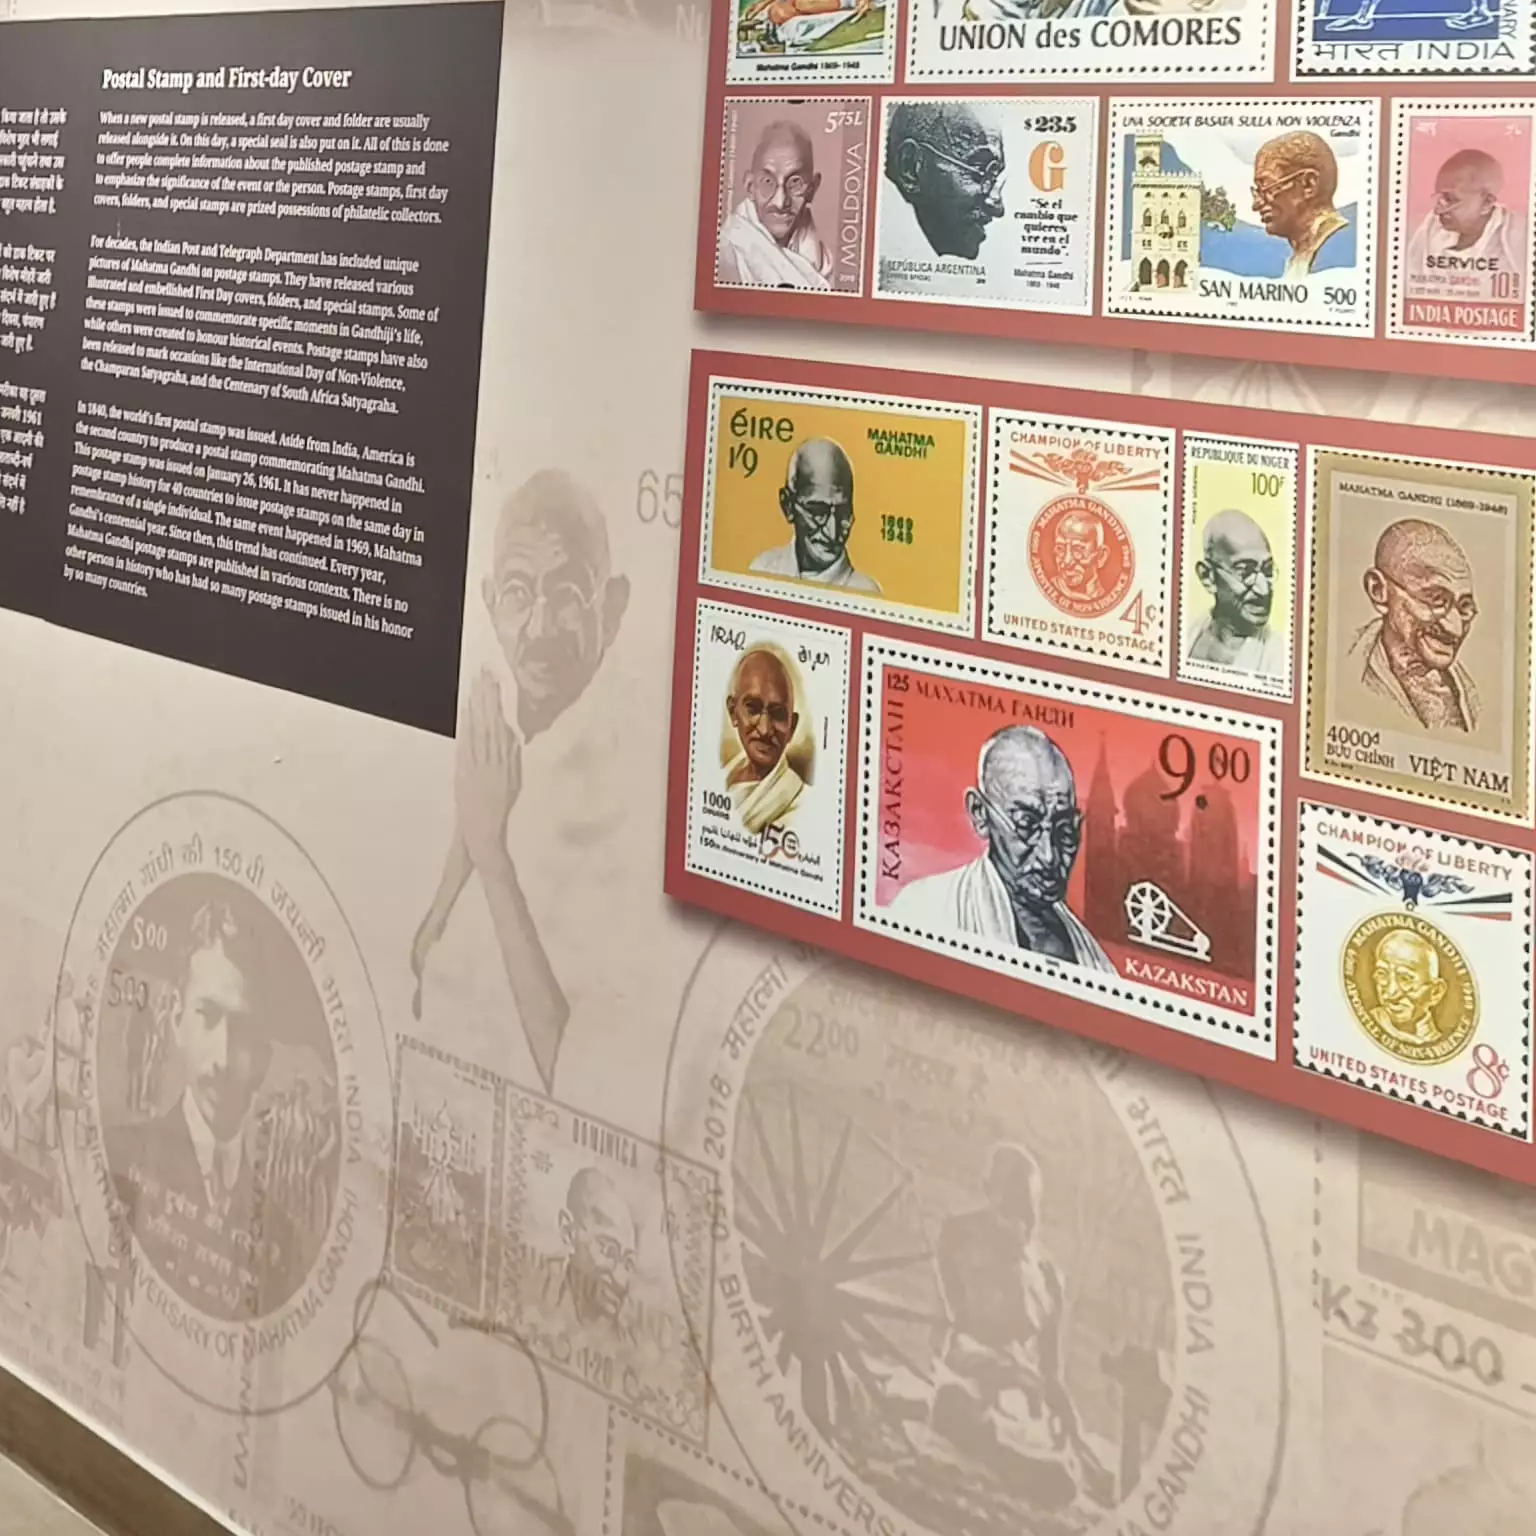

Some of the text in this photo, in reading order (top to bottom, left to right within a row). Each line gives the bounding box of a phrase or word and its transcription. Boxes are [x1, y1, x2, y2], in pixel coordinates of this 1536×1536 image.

[939, 16, 1242, 51] UNION des COMORES
[1313, 41, 1404, 61] भारत
[1417, 41, 1516, 61] INDIA
[102, 65, 353, 94] Postal Stamp and First-day Cover
[256, 112, 275, 126] first
[276, 112, 293, 129] day
[295, 115, 321, 126] cover
[322, 113, 341, 126] and
[343, 113, 372, 127] folder
[374, 116, 390, 127] are
[392, 113, 428, 130] usually
[1122, 116, 1145, 128] UNA
[1194, 115, 1235, 127] BASATA
[1237, 115, 1273, 127] SULLA
[1275, 115, 1302, 127] NON
[1306, 115, 1362, 127] VIOLENZA
[1028, 140, 1068, 193] G
[230, 202, 245, 214] are
[247, 200, 276, 218] prized
[277, 202, 330, 221] possessions
[331, 205, 341, 219] of
[343, 205, 388, 224] philatelic
[390, 208, 442, 224] collectors.
[840, 142, 865, 269] MOLDOVA
[1057, 212, 1079, 224] que
[1426, 255, 1501, 272] SERVICE
[1199, 279, 1309, 304] SAN MARINO
[1323, 286, 1358, 306] 500
[1489, 271, 1510, 298] 10
[1409, 303, 1520, 328] INDIA POSTAGE
[867, 427, 937, 449] MAHATMA
[874, 442, 929, 460] GANDHI
[1010, 431, 1082, 450] CHAMPION
[1104, 442, 1162, 461] LIBERTY
[159, 435, 193, 457] produce
[195, 444, 201, 456] a
[202, 442, 228, 463] postal
[230, 447, 257, 468] stamp
[258, 452, 335, 481] commemorating
[336, 465, 383, 486] Mahatma
[385, 473, 424, 493] Gandhi.
[1338, 481, 1395, 500] MAHATMA
[1398, 490, 1444, 508] GANDHI
[1003, 613, 1157, 654] UNITED STATES POSTAGE
[887, 672, 911, 693] 125
[915, 678, 1075, 730] МАХАТМА ГАНДИ
[881, 699, 906, 882] КАЗАКСТАН
[1463, 768, 1511, 794] NAM
[701, 789, 732, 812] 1000
[1316, 821, 1410, 854] CHAMPION
[1437, 851, 1514, 882] LIBERTY
[1124, 956, 1249, 1008] KAZAKSTAN
[1309, 1046, 1510, 1122] UNITED STATES POSTAGE
[1394, 1306, 1505, 1387] 300
[1143, 1232, 1216, 1531] INDIA GANDHI
